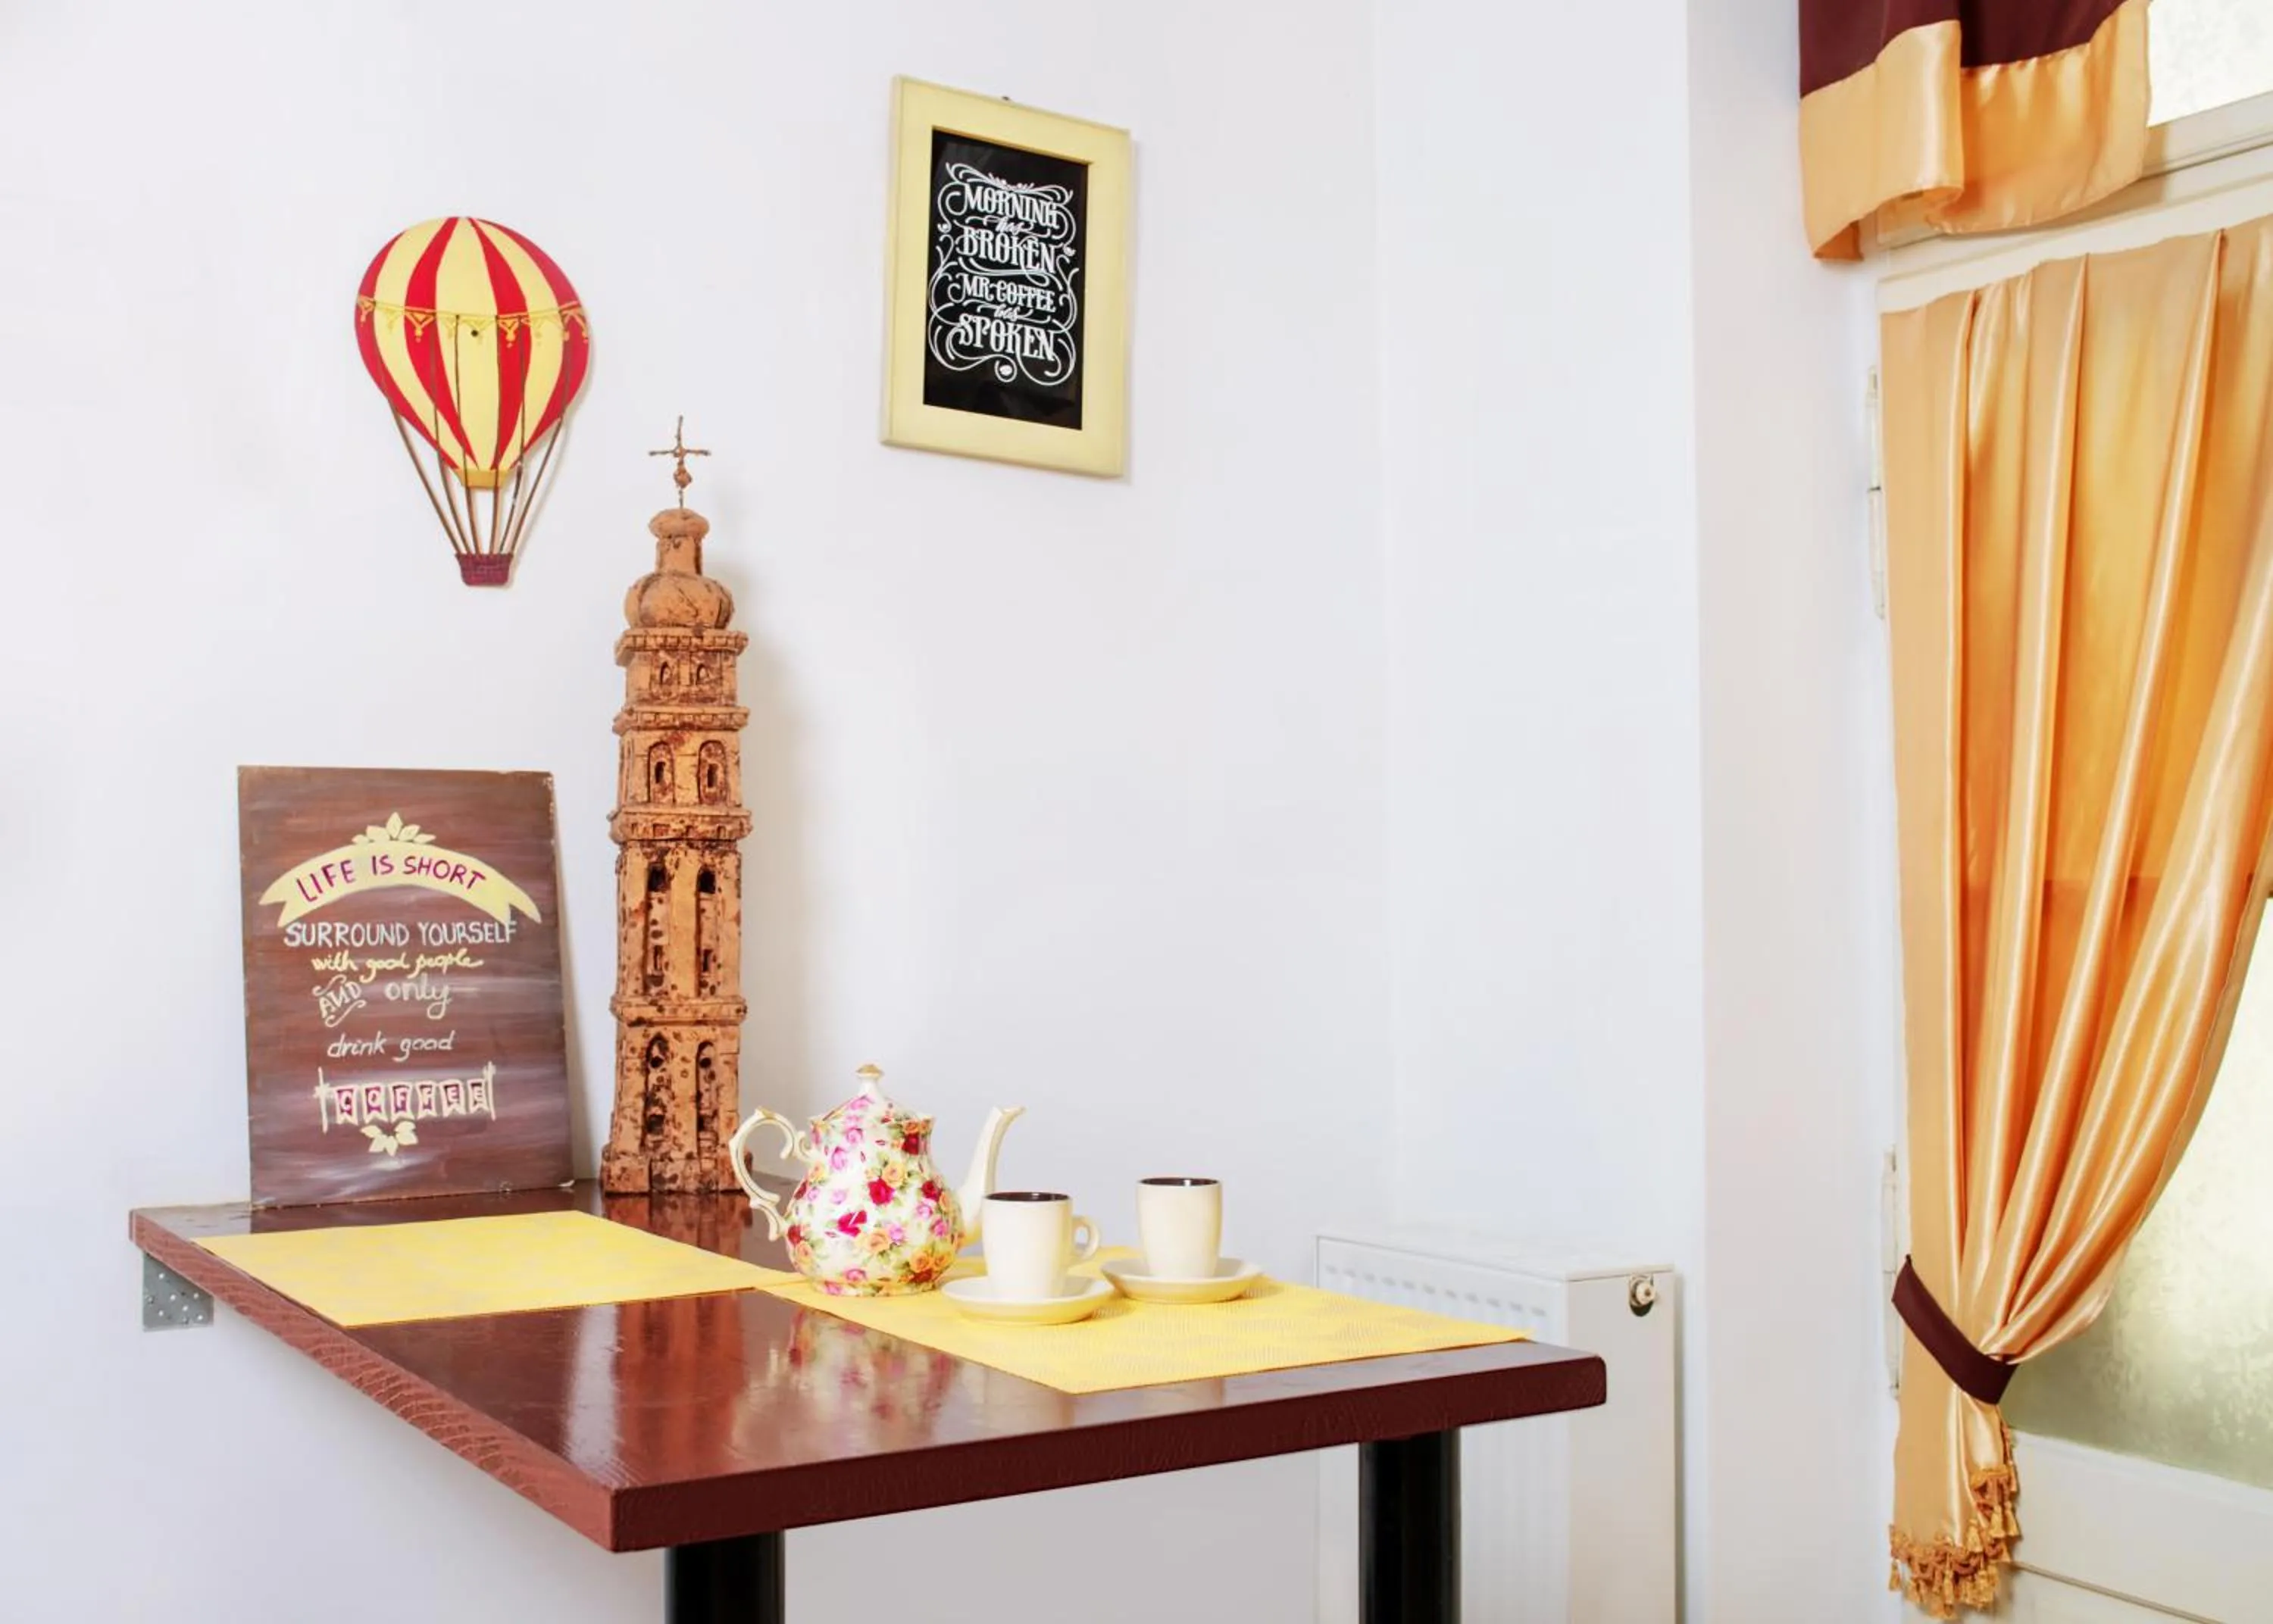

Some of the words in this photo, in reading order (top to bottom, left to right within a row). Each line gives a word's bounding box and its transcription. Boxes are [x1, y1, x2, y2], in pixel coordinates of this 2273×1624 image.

[956, 226, 1056, 274] BROKEN
[993, 280, 1056, 313] COFFEE
[957, 314, 1056, 361] SPOKEN
[295, 859, 357, 903] LIFE
[371, 854, 396, 876] IS
[403, 856, 487, 890] SHORT
[283, 921, 410, 948] SURROUND
[417, 920, 518, 945] YOURSELF
[311, 950, 358, 971] with
[359, 952, 410, 982] good
[407, 948, 485, 979] people
[317, 980, 364, 1019] AND
[384, 973, 453, 1020] only
[327, 1031, 387, 1058] drink
[392, 1030, 456, 1062] good
[337, 1082, 486, 1115] COFFEE
